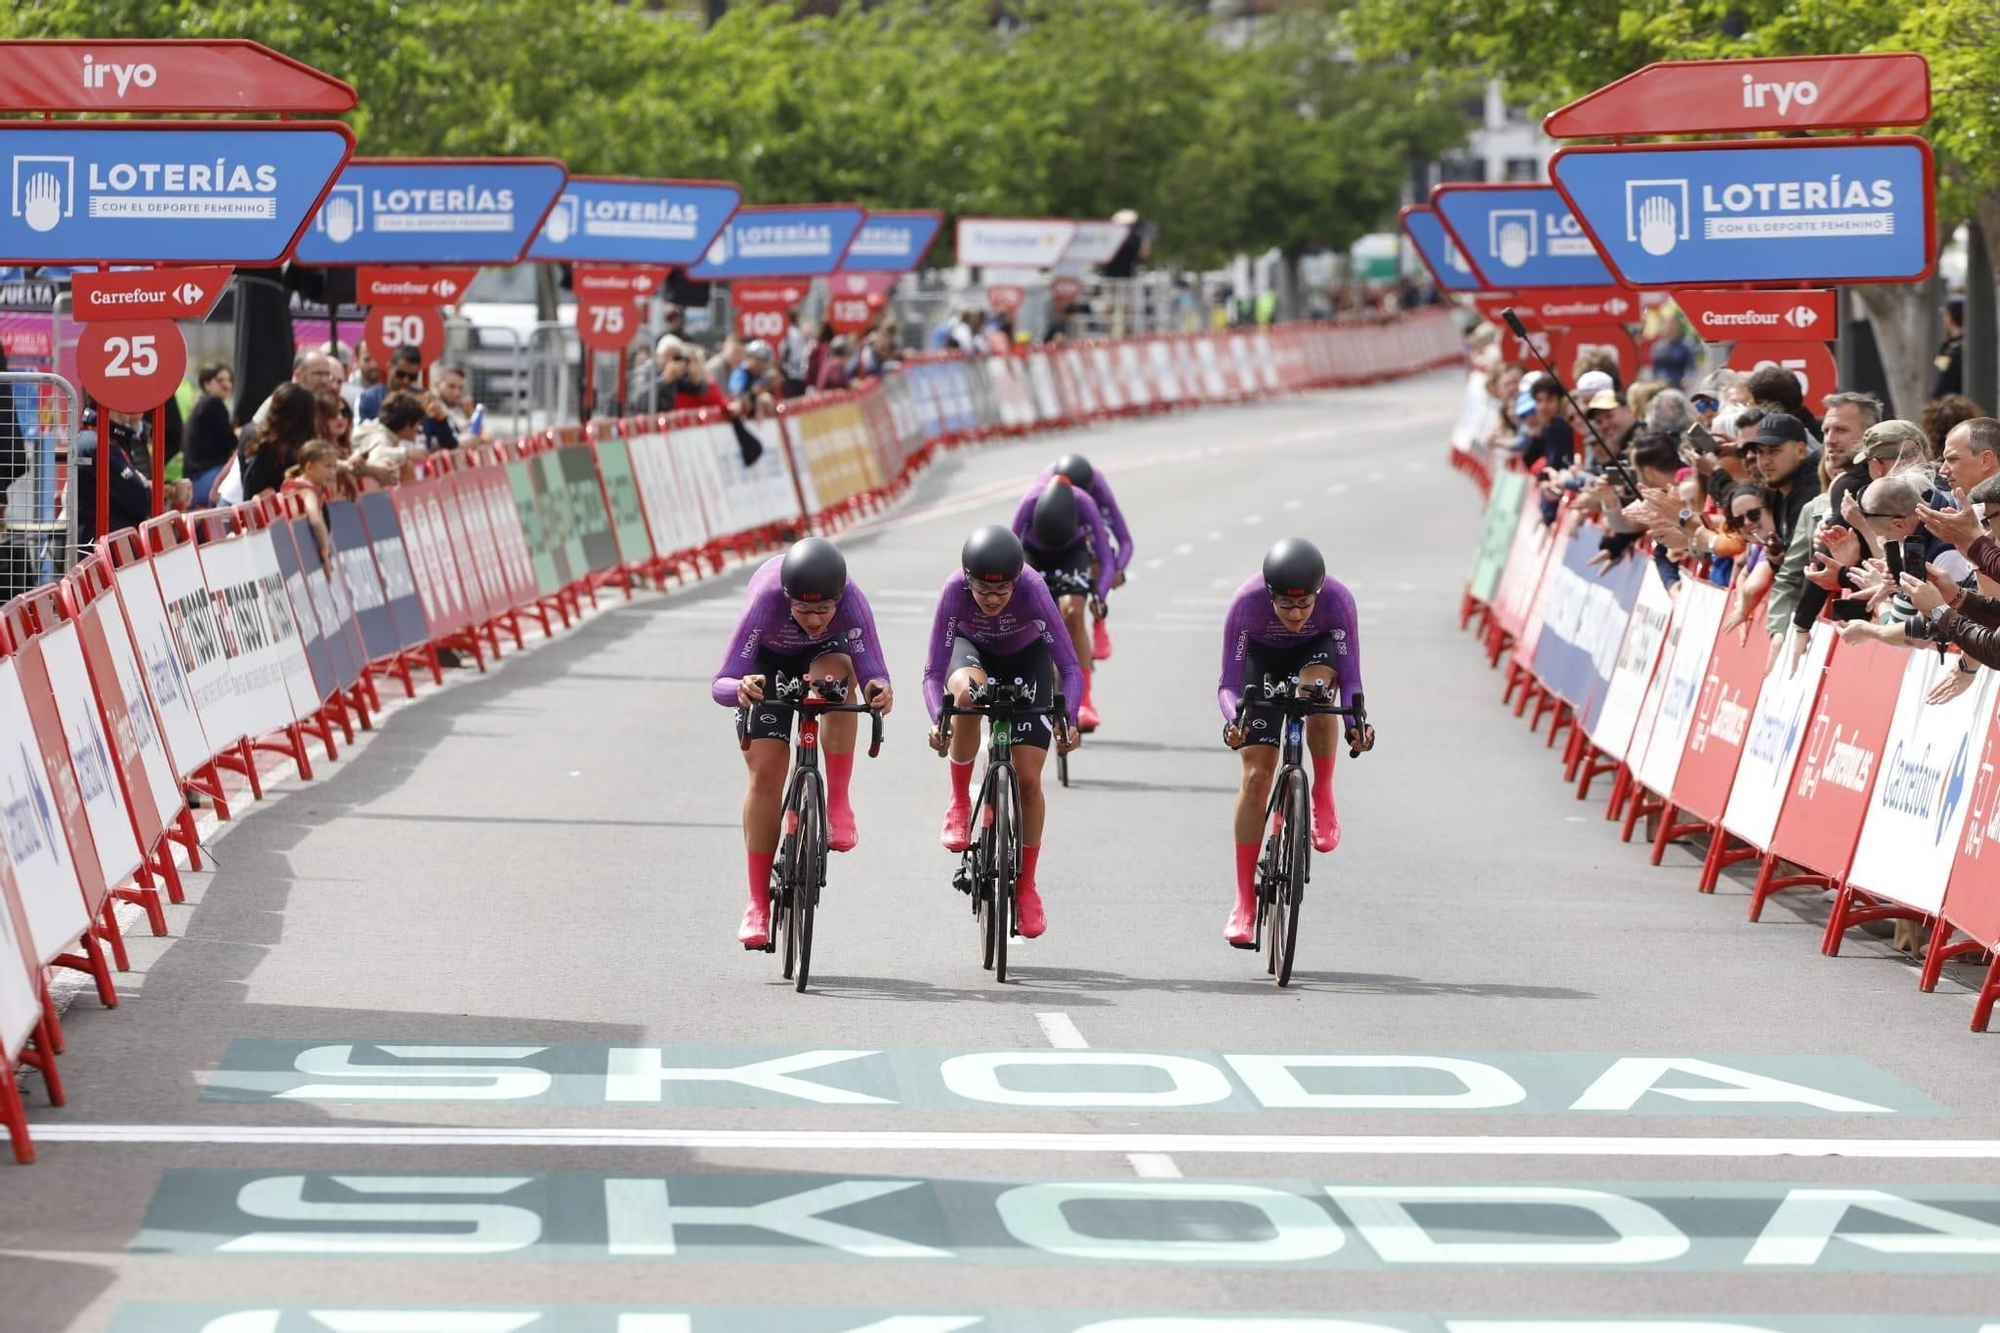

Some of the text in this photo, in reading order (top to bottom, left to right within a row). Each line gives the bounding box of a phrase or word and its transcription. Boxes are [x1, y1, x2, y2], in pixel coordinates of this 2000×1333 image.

[83, 54, 157, 98] iryo
[1742, 73, 1818, 116] iryo
[89, 158, 277, 192] LOTERÍAS
[372, 184, 514, 211] LOTERÍAS
[1702, 174, 1894, 212] LOTERÍAS
[102, 203, 265, 213] CON EL DEPORTE FEMENINO
[584, 199, 699, 222] LOTERÍAS
[1717, 219, 1882, 233] CON EL DEPORTE FEMENINO
[90, 288, 166, 305] Carrefour
[589, 306, 625, 333] 75
[741, 312, 784, 336] 100
[833, 301, 868, 321] 125
[1702, 310, 1779, 326] Carrefour
[381, 315, 424, 347] 50
[103, 335, 158, 378] 25
[1882, 739, 1942, 819] Carrefour
[272, 1044, 1897, 1113] SKODA
